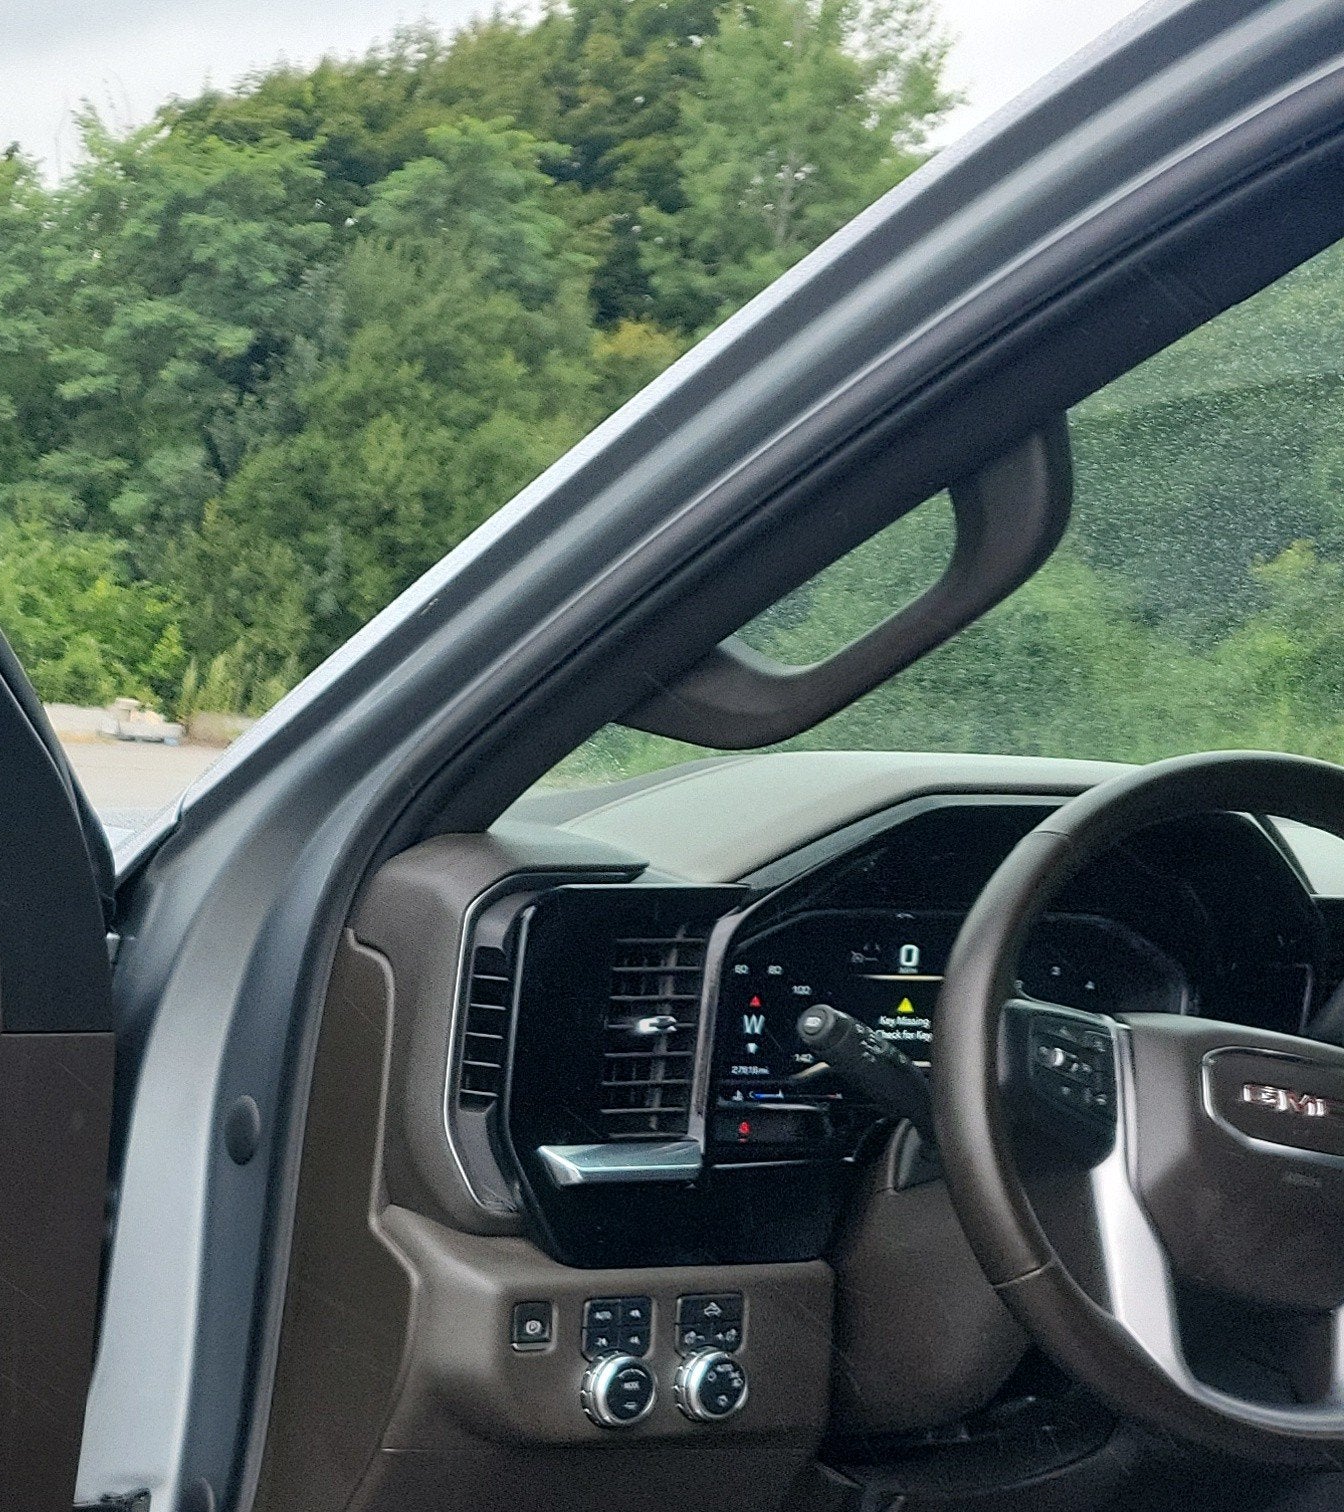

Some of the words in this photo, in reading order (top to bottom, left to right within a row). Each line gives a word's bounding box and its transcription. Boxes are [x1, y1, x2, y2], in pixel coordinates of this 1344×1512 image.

[743, 1013, 765, 1034] W
[879, 1015, 895, 1028] Key
[896, 1015, 931, 1029] Missing
